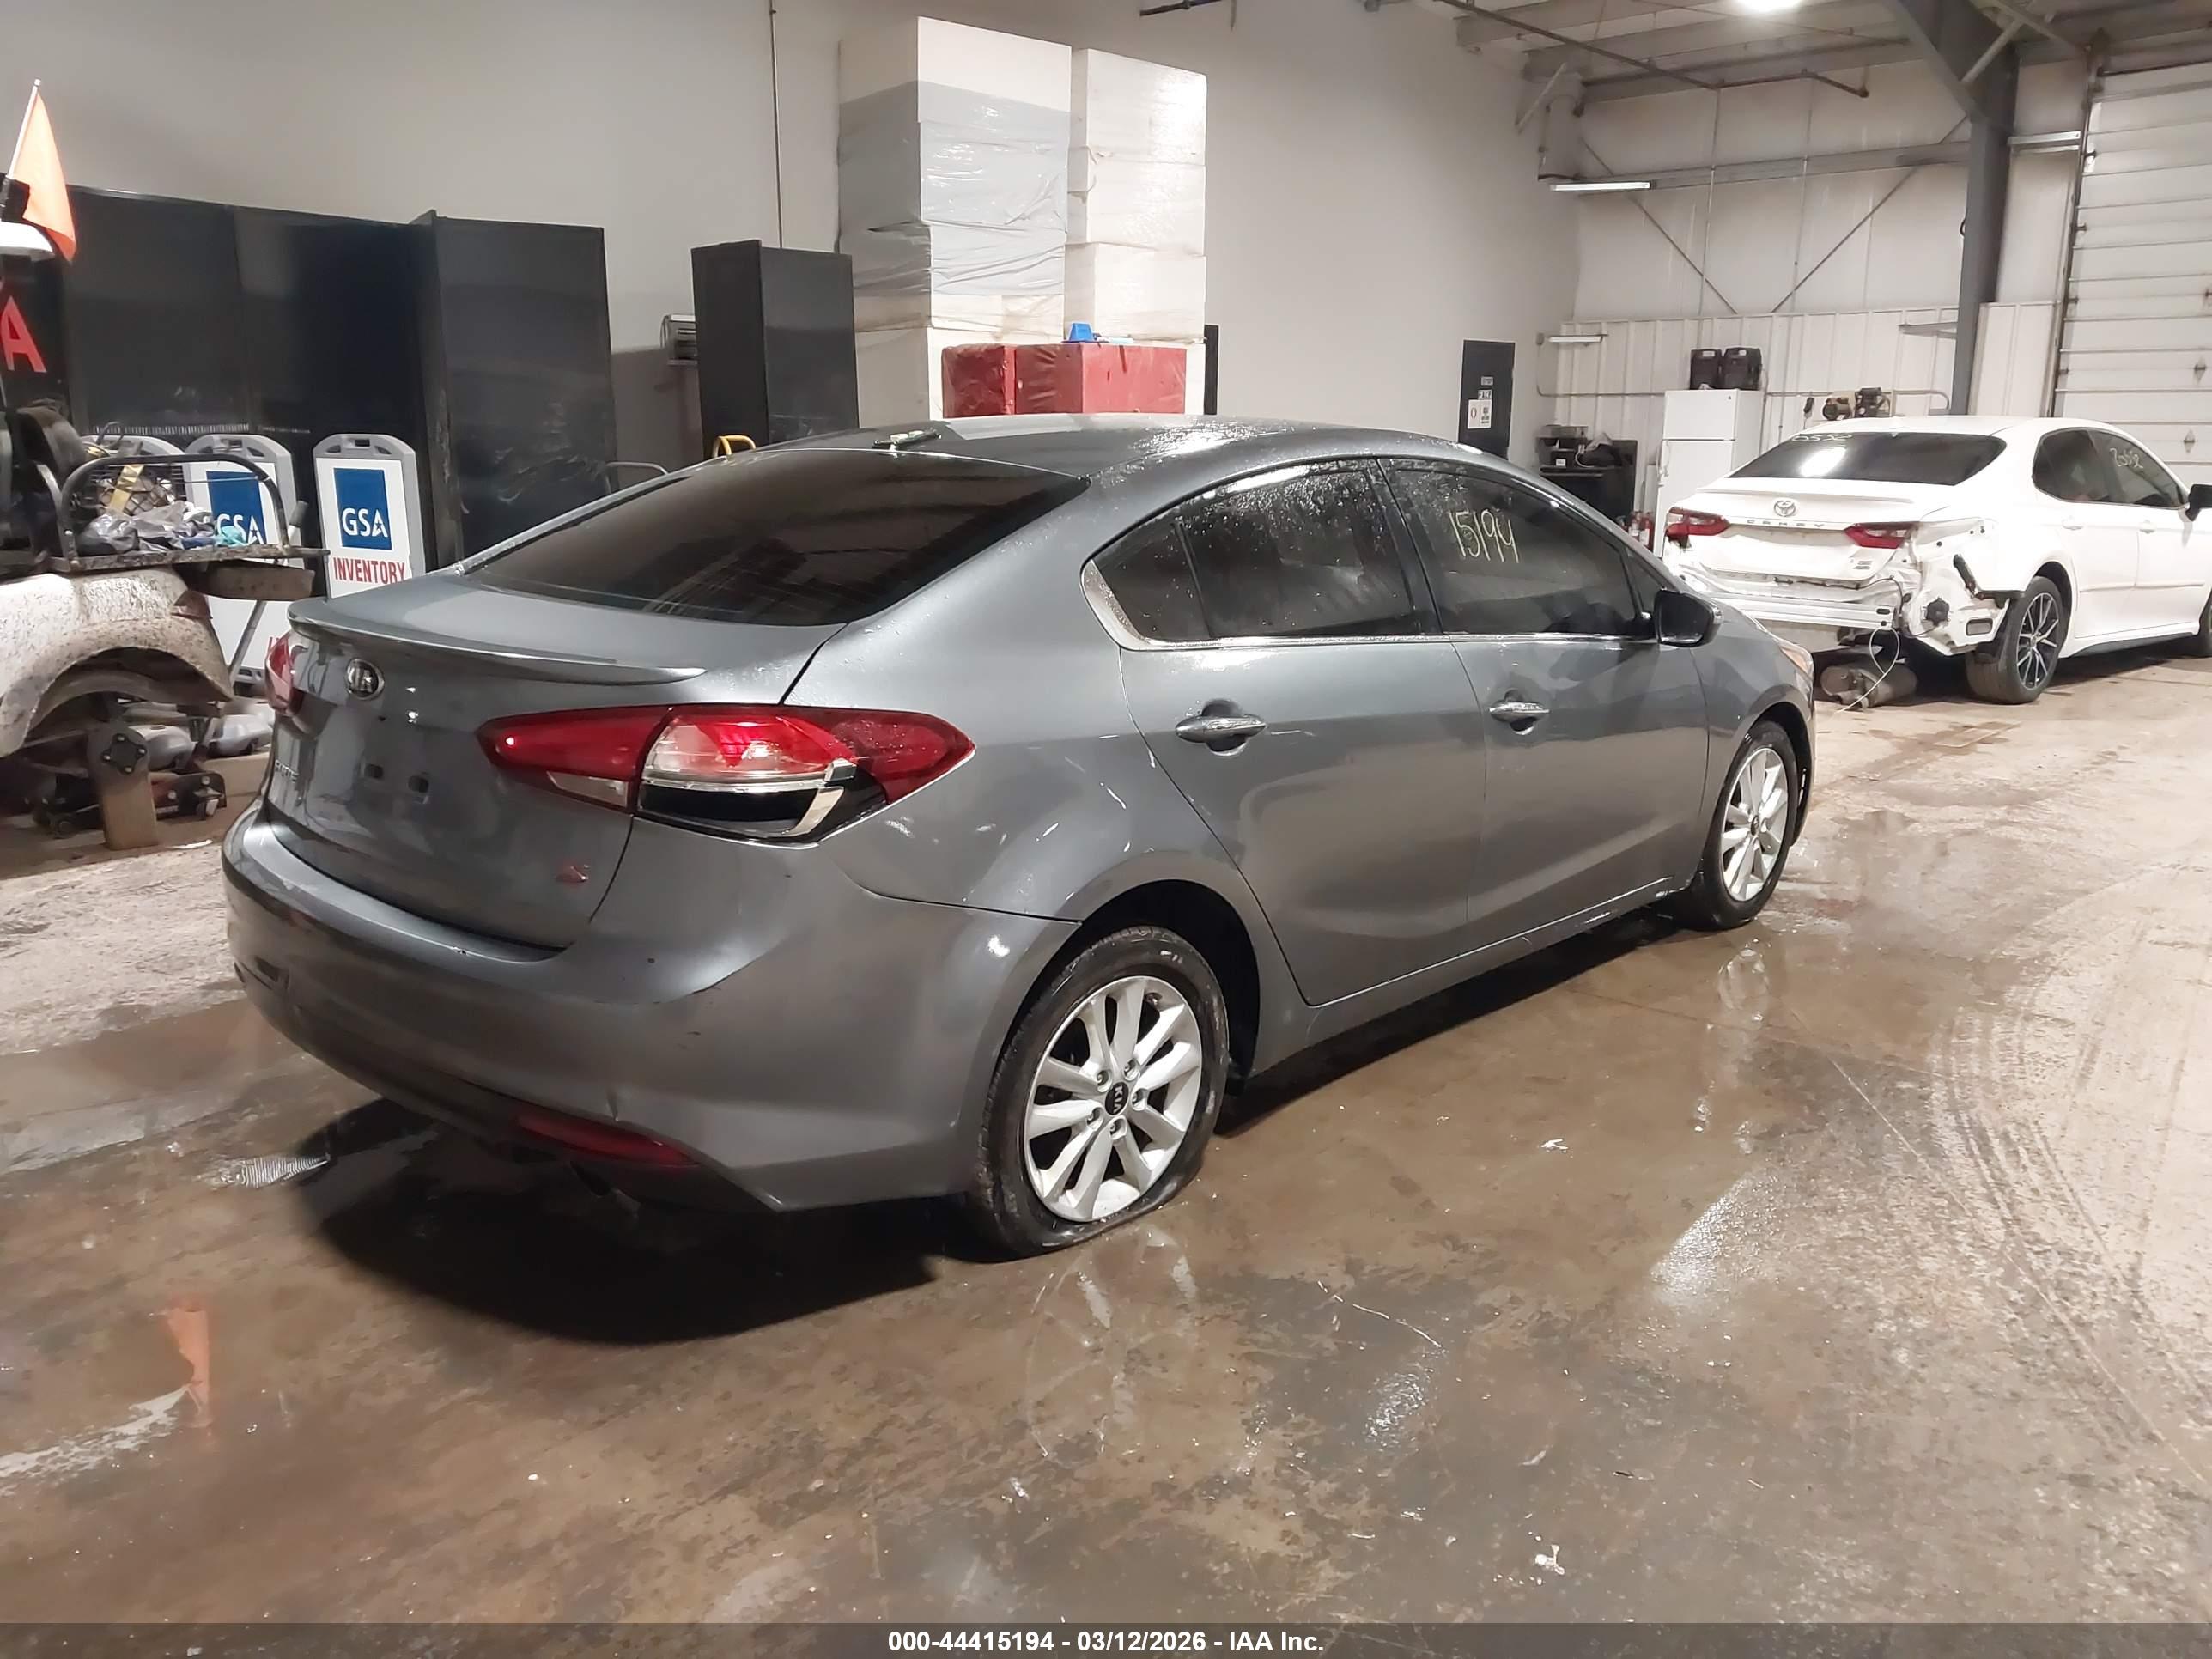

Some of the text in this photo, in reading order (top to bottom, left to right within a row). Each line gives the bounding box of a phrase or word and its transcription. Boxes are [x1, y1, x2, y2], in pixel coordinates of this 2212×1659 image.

[342, 507, 388, 538] GSA
[1449, 509, 1519, 563] 15194
[333, 557, 404, 584] INVENTORY
[1114, 1085, 1123, 1114] KIA
